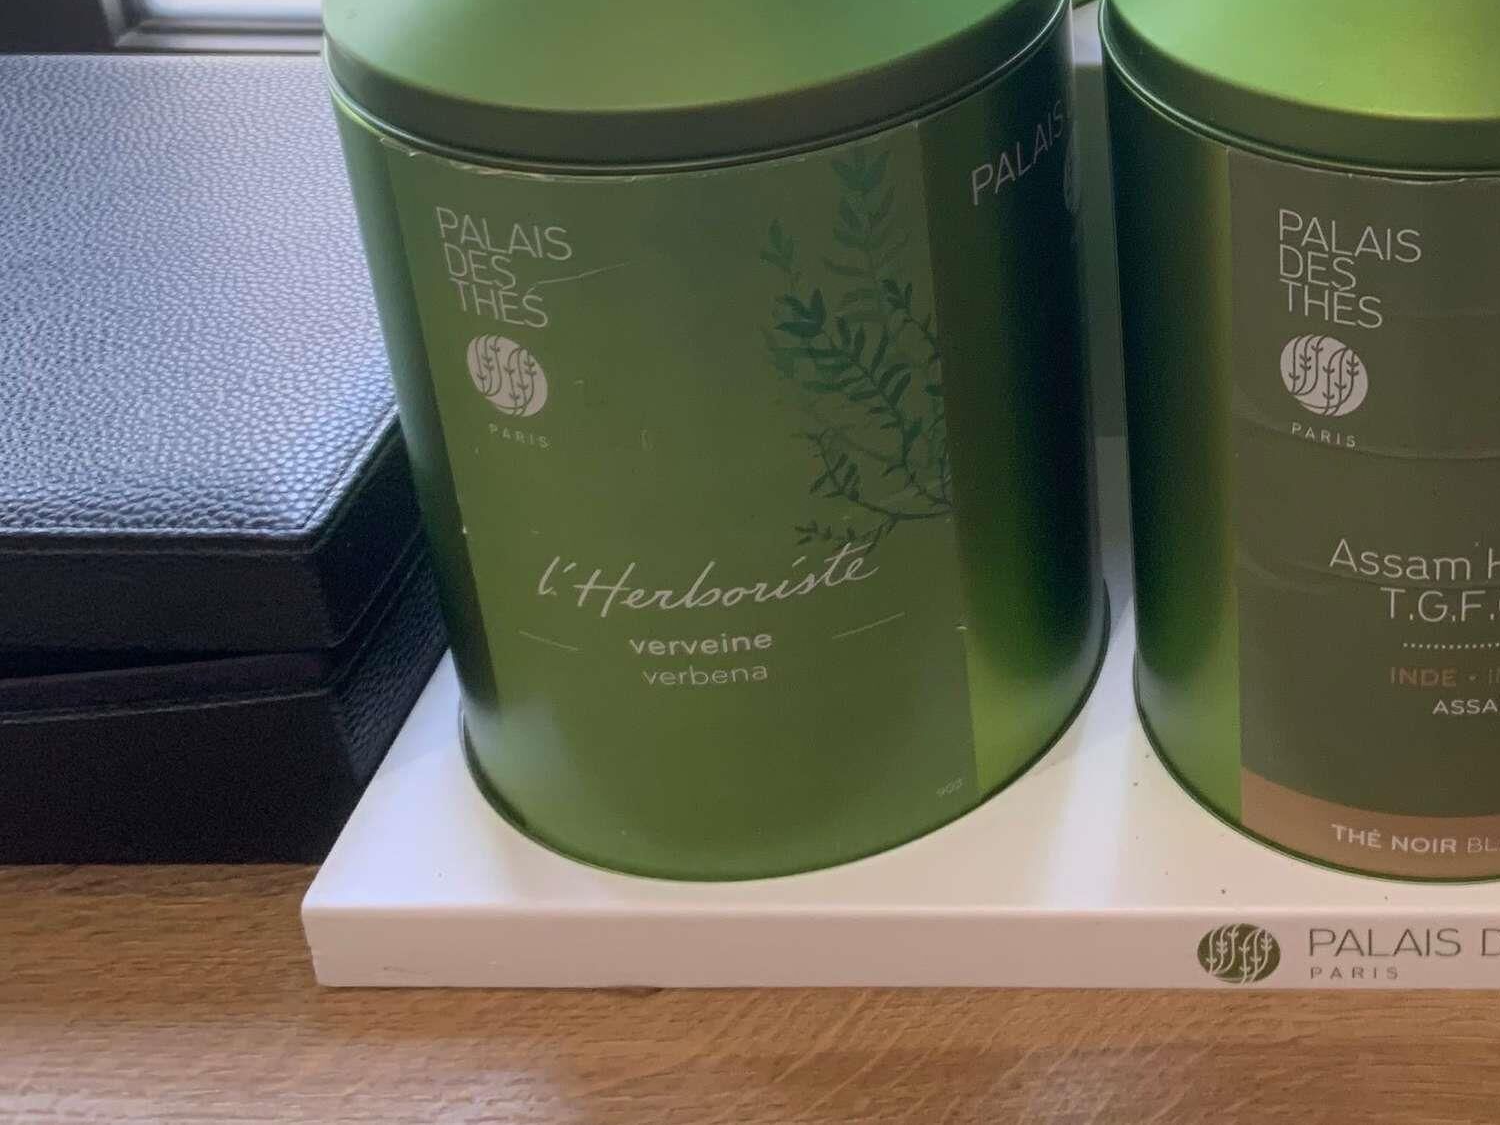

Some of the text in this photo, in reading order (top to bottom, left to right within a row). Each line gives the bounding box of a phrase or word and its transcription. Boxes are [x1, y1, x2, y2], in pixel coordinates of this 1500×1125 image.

[972, 100, 1063, 206] PALAIS
[436, 206, 572, 261] PALAIS
[1279, 209, 1422, 263] PALAIS
[444, 242, 516, 290] DES
[1279, 243, 1357, 290] DES
[488, 423, 549, 449] PARIS
[1291, 422, 1357, 449] PARIS
[1329, 538, 1471, 581] Assam
[538, 541, 880, 618] l'Herboriste
[630, 633, 773, 656] verveine
[643, 664, 768, 686] verbena
[1390, 666, 1457, 687] INDE
[1331, 823, 1382, 849] THÉ
[1391, 836, 1457, 854] NOIR
[1308, 927, 1462, 958] PALAIS
[1309, 965, 1400, 981] PARIS
